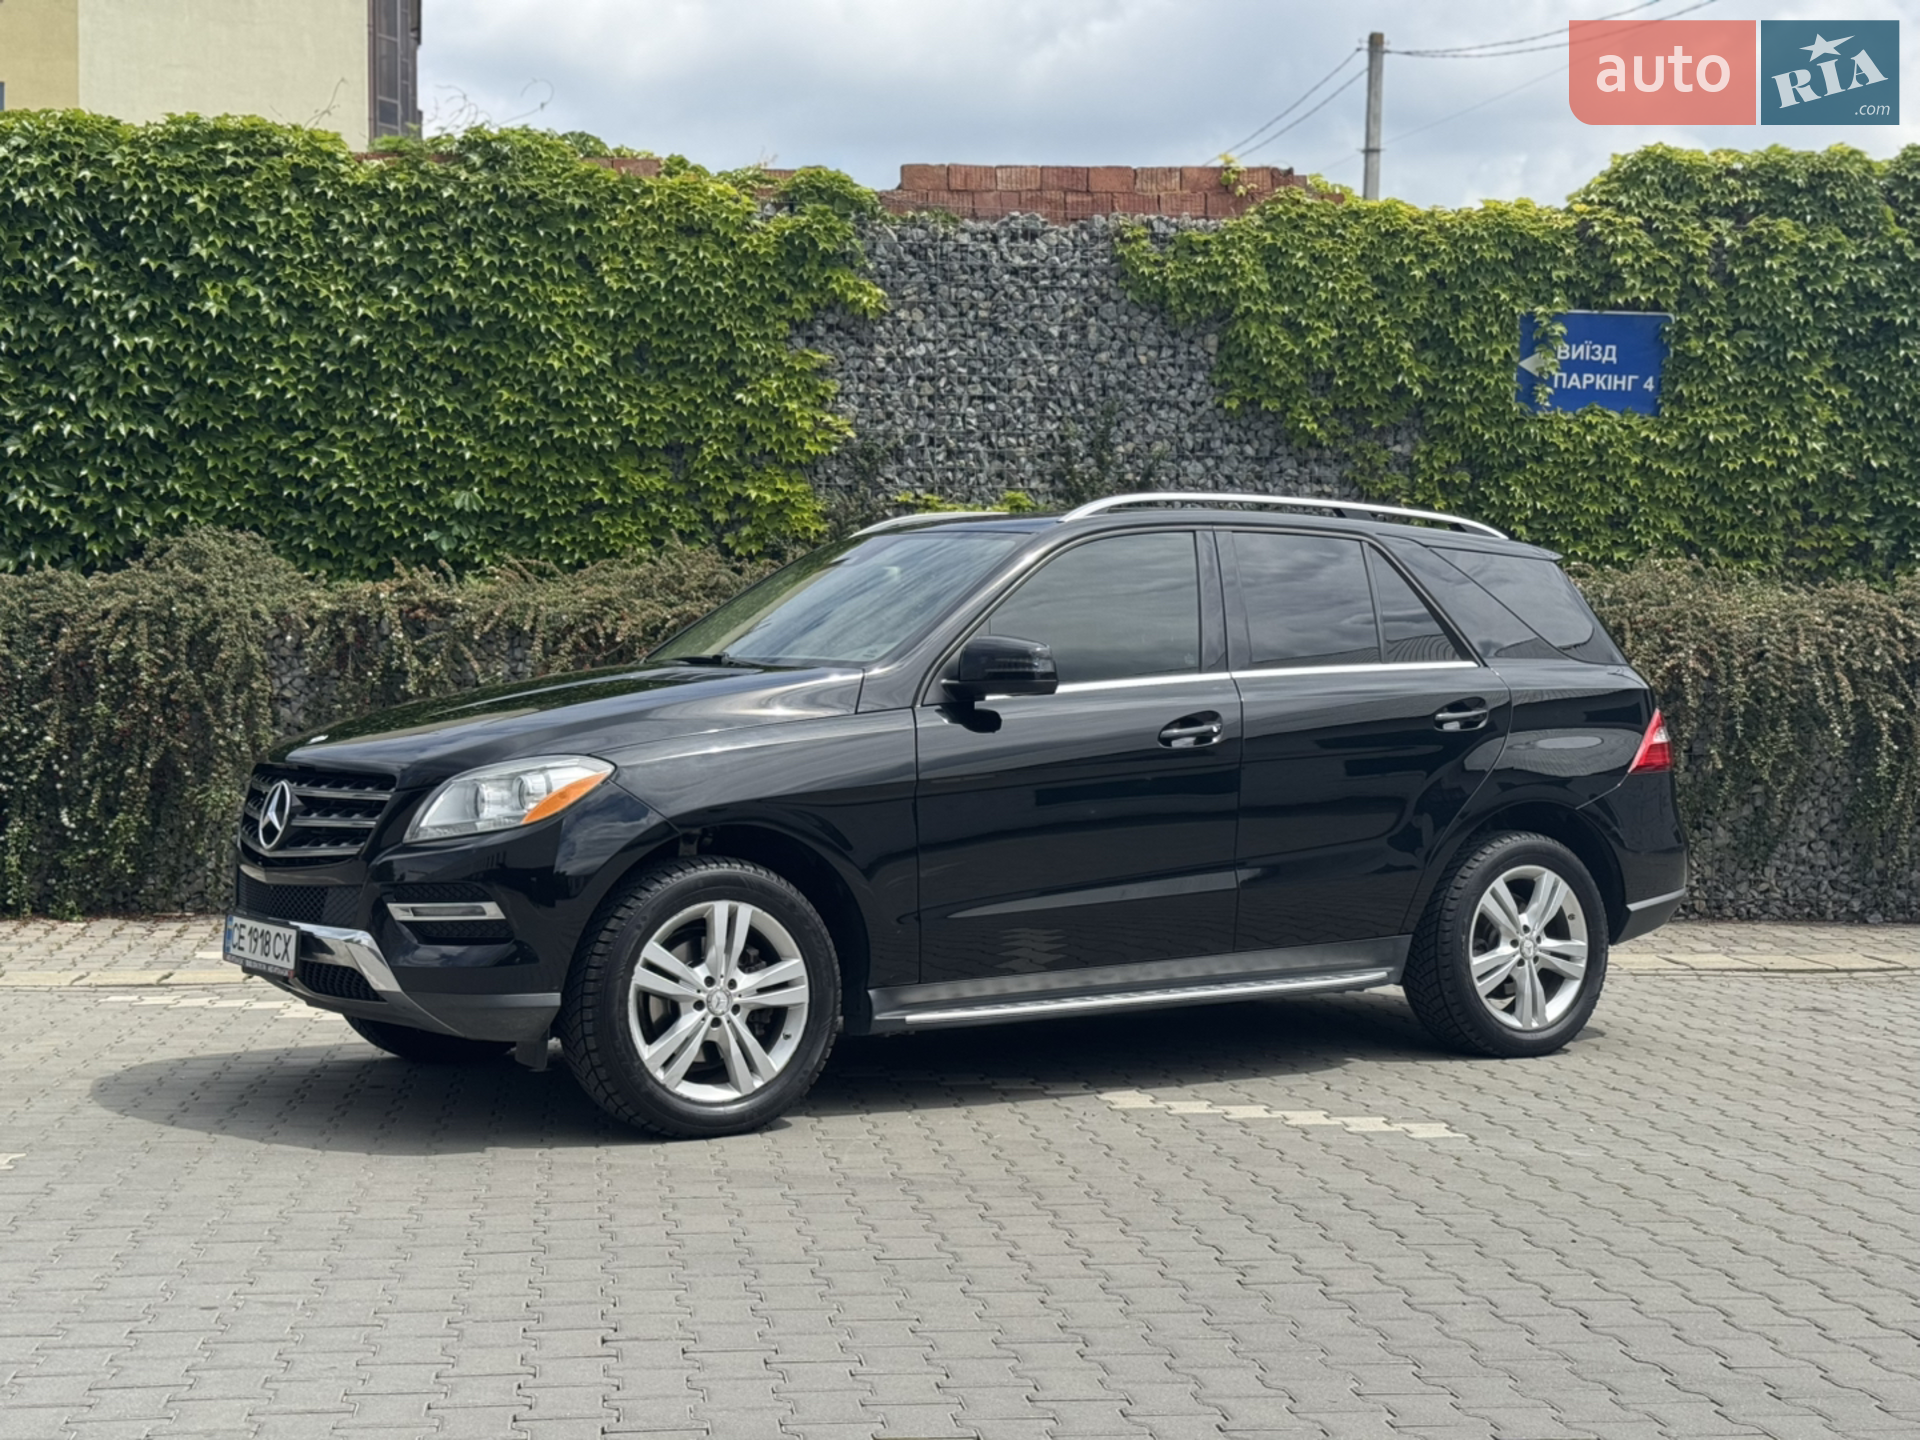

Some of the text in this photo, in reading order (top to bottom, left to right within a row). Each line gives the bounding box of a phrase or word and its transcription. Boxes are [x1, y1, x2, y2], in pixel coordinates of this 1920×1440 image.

[1556, 340, 1617, 364] ВИЇЗД
[1553, 373, 1655, 392] ПАРКІНГ 4
[232, 922, 292, 962] CE 1918 CX
